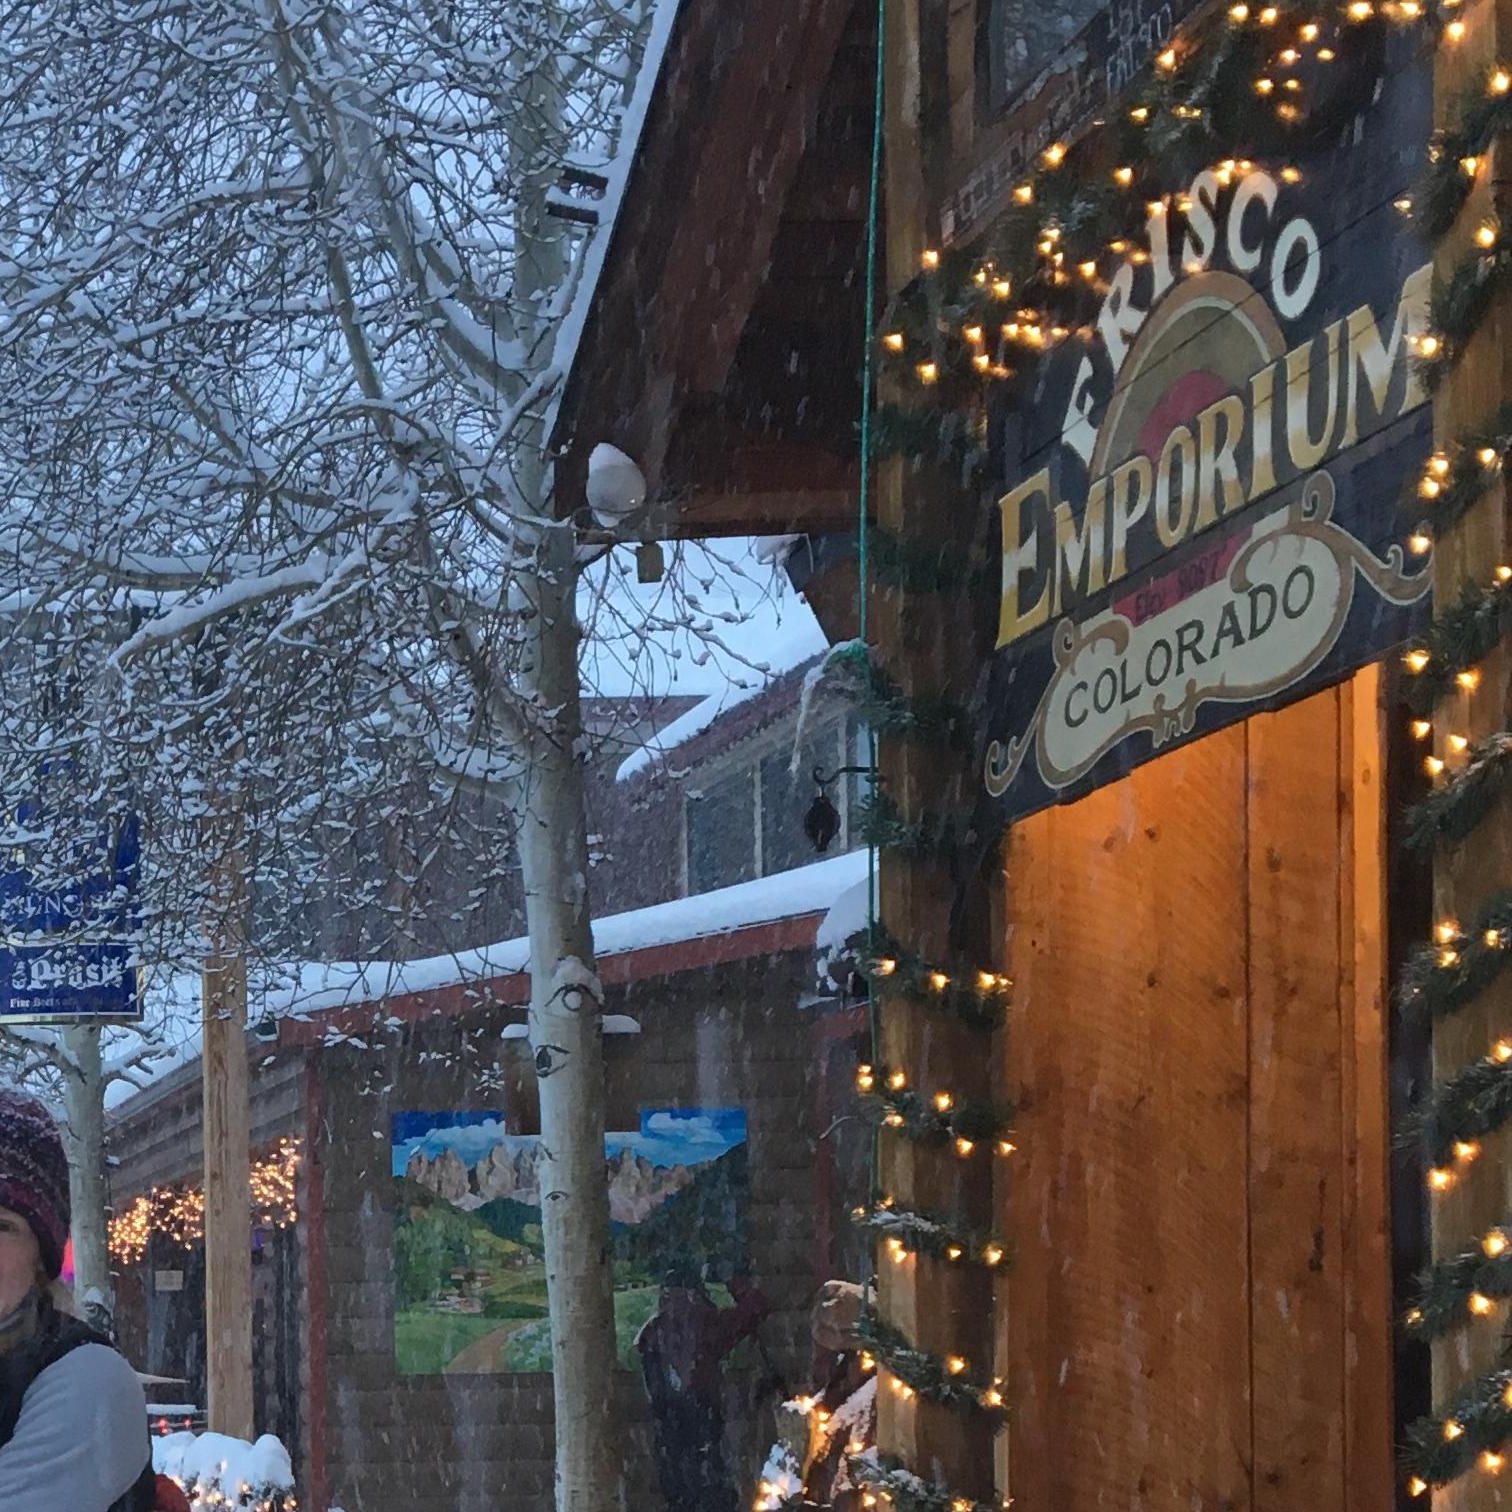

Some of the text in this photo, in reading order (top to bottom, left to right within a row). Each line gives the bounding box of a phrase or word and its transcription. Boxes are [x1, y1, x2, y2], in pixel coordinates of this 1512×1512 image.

[996, 264, 1434, 650] EMPORIUM
[1061, 170, 1321, 467] FRISCO
[1064, 564, 1315, 728] COLORADO
